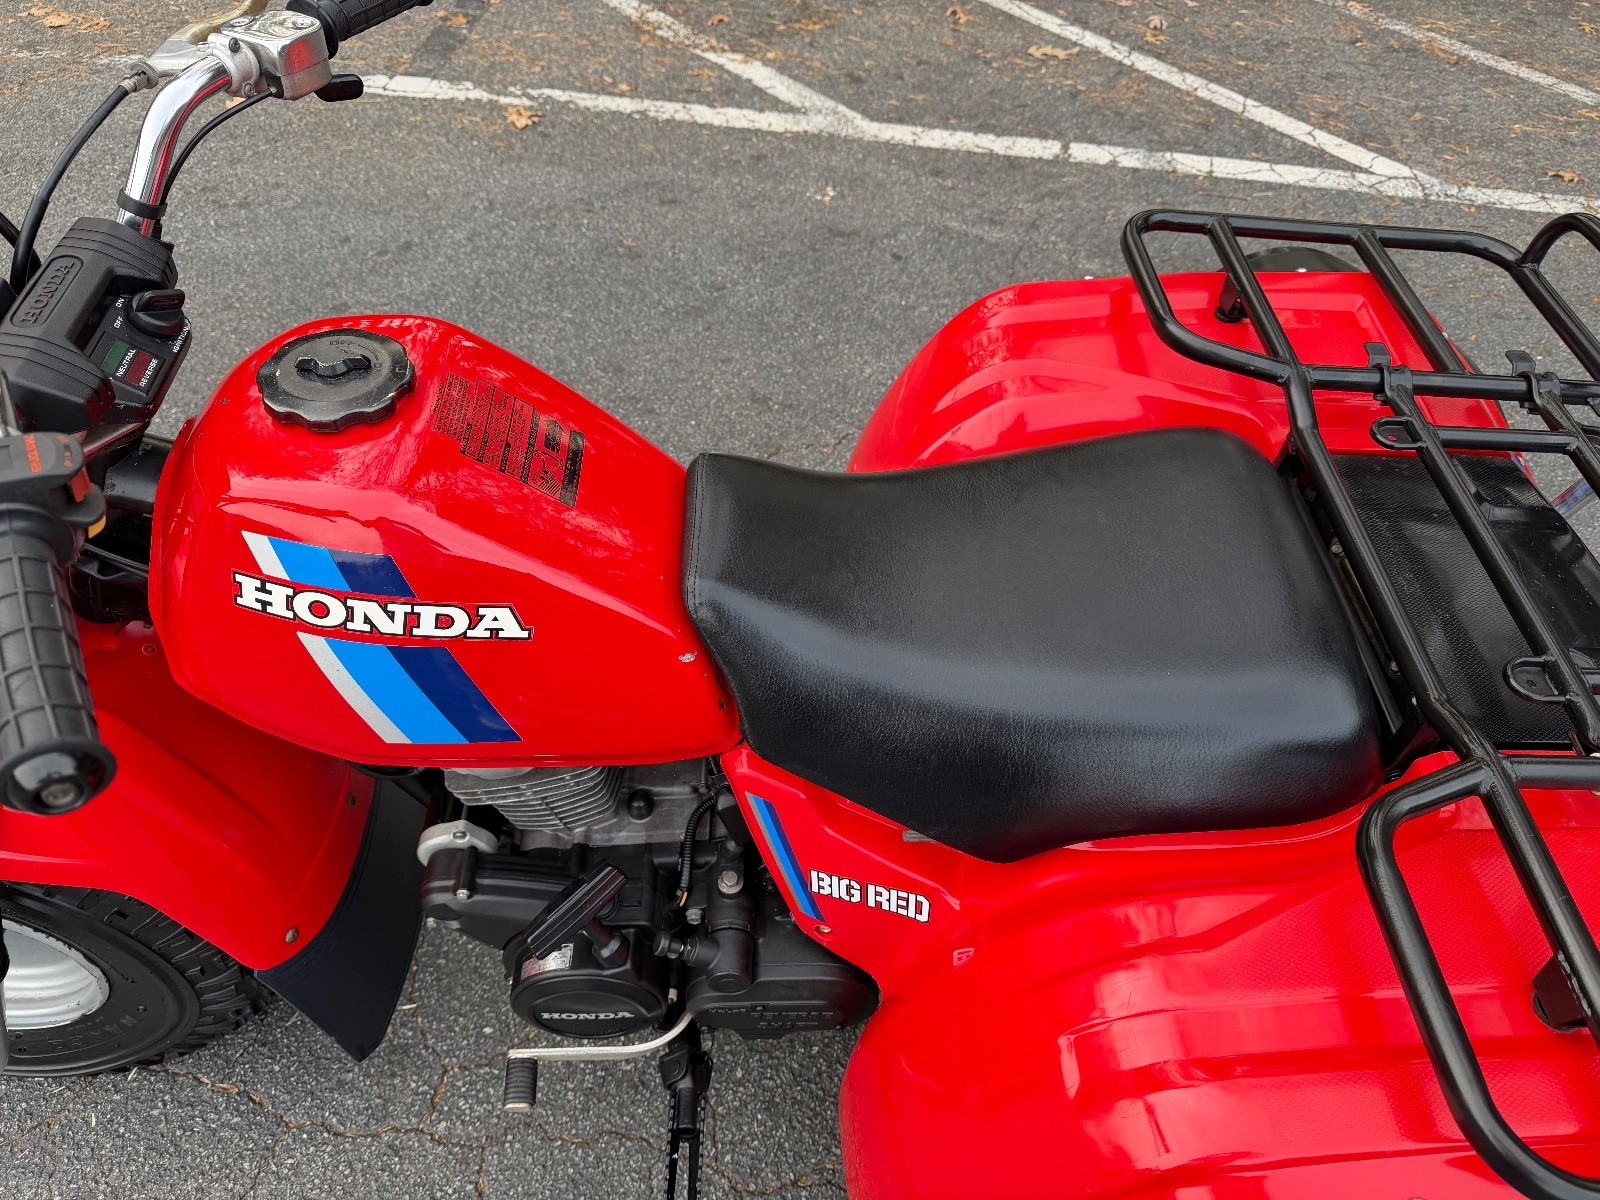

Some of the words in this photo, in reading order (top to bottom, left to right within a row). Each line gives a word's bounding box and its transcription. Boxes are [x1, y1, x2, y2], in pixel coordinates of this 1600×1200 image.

[20, 262, 75, 324] HONDA
[115, 297, 125, 308] ON
[113, 316, 124, 329] OFF
[116, 349, 137, 377] NEUTRAL
[140, 358, 158, 387] REVERSE
[233, 571, 531, 640] HONDA
[810, 869, 862, 903] BIG
[866, 883, 931, 923] RED
[540, 1011, 635, 1020] HONDA
